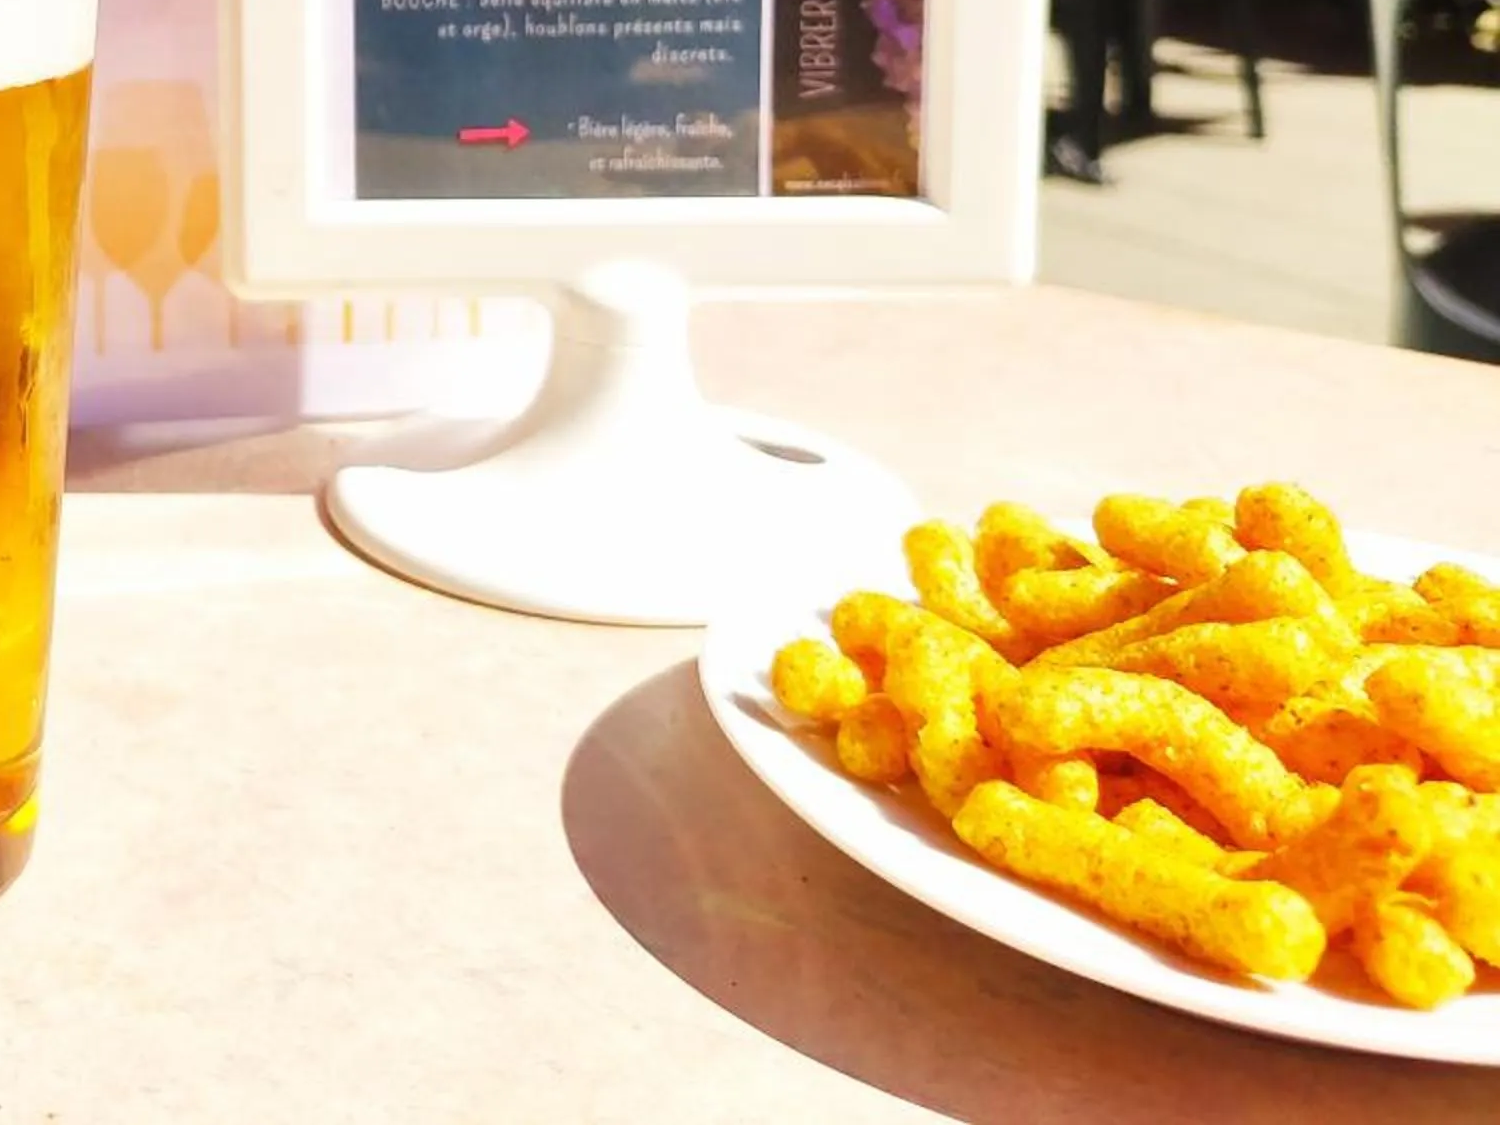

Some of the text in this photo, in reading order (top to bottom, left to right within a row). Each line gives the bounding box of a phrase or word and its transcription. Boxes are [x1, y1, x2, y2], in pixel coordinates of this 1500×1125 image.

[437, 23, 457, 39] et
[525, 11, 607, 38] houblons
[613, 20, 694, 40] présents
[699, 16, 742, 33] mais
[652, 39, 735, 64] discrets.
[798, 0, 838, 98] VIBRER
[589, 159, 605, 172] et
